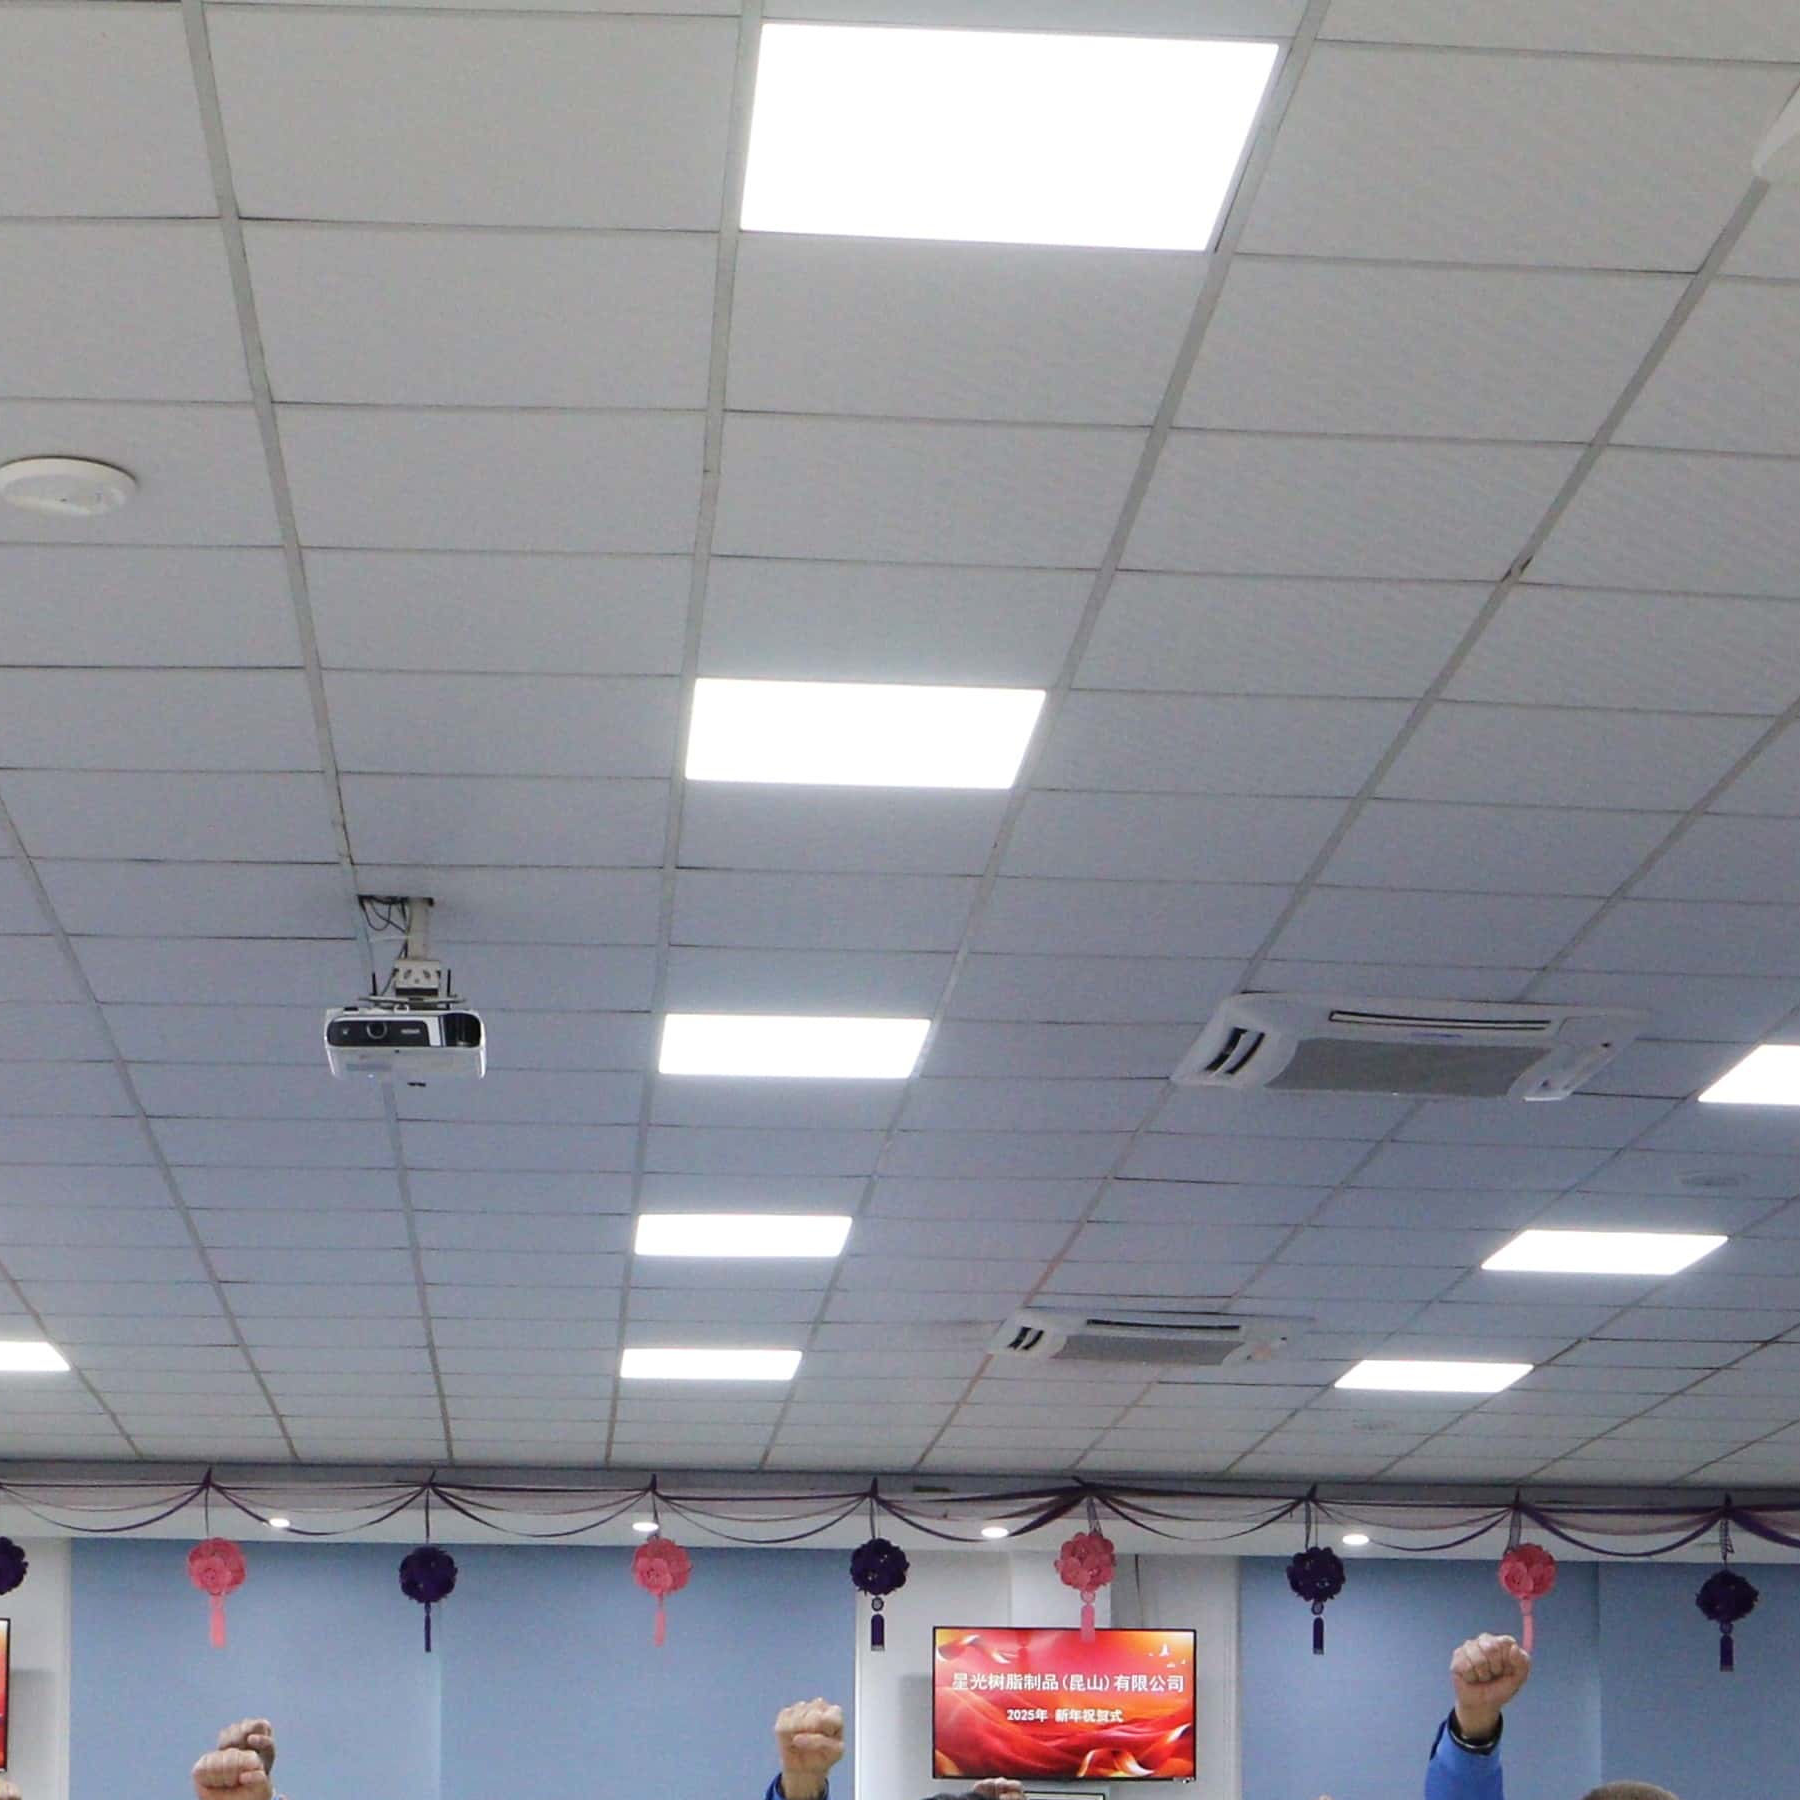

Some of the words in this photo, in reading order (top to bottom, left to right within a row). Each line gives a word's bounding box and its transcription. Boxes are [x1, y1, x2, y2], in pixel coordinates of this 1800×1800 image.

[1006, 1708, 1048, 1722] 2025年
[1055, 1708, 1124, 1723] 新年祝贺式
